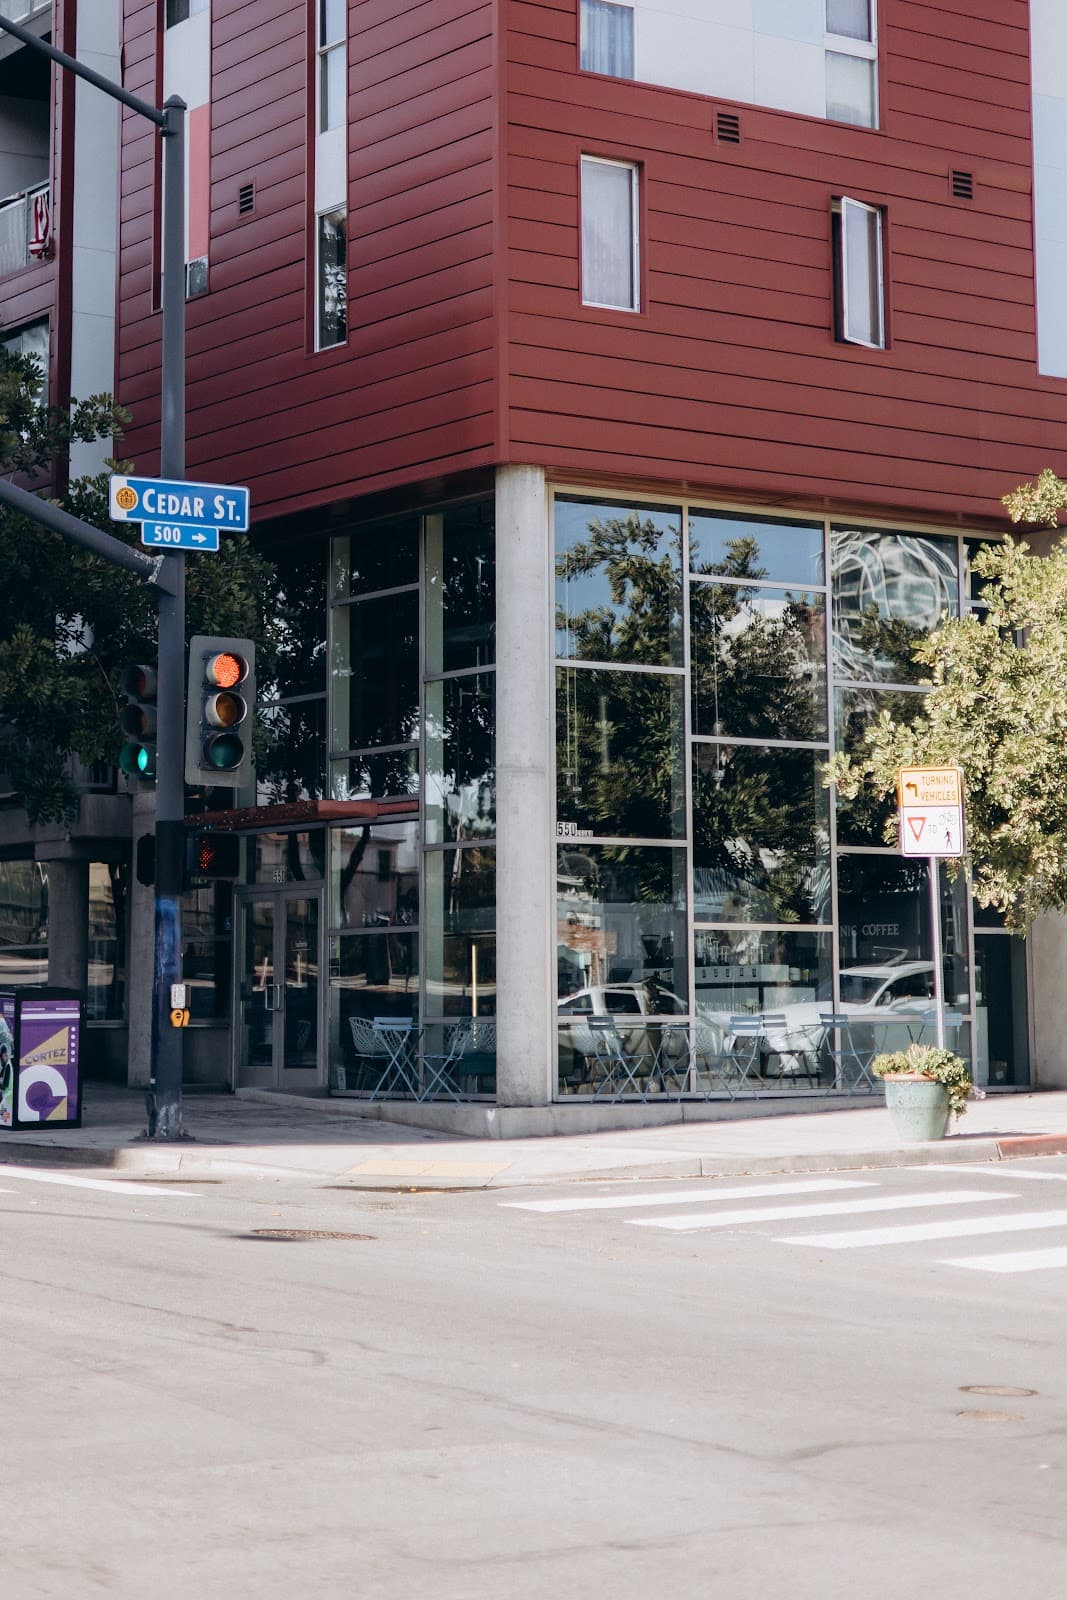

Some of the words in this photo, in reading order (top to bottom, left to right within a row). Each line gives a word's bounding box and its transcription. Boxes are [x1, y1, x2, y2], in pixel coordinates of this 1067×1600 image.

[142, 488, 205, 518] CEDAR
[213, 495, 241, 521] ST.
[154, 526, 182, 543] 500
[922, 775, 954, 786] TURNING
[921, 791, 957, 801] VEHICLES
[557, 822, 577, 836] 550
[862, 923, 900, 936] COFFEE
[25, 1048, 66, 1064] CORTEZ
